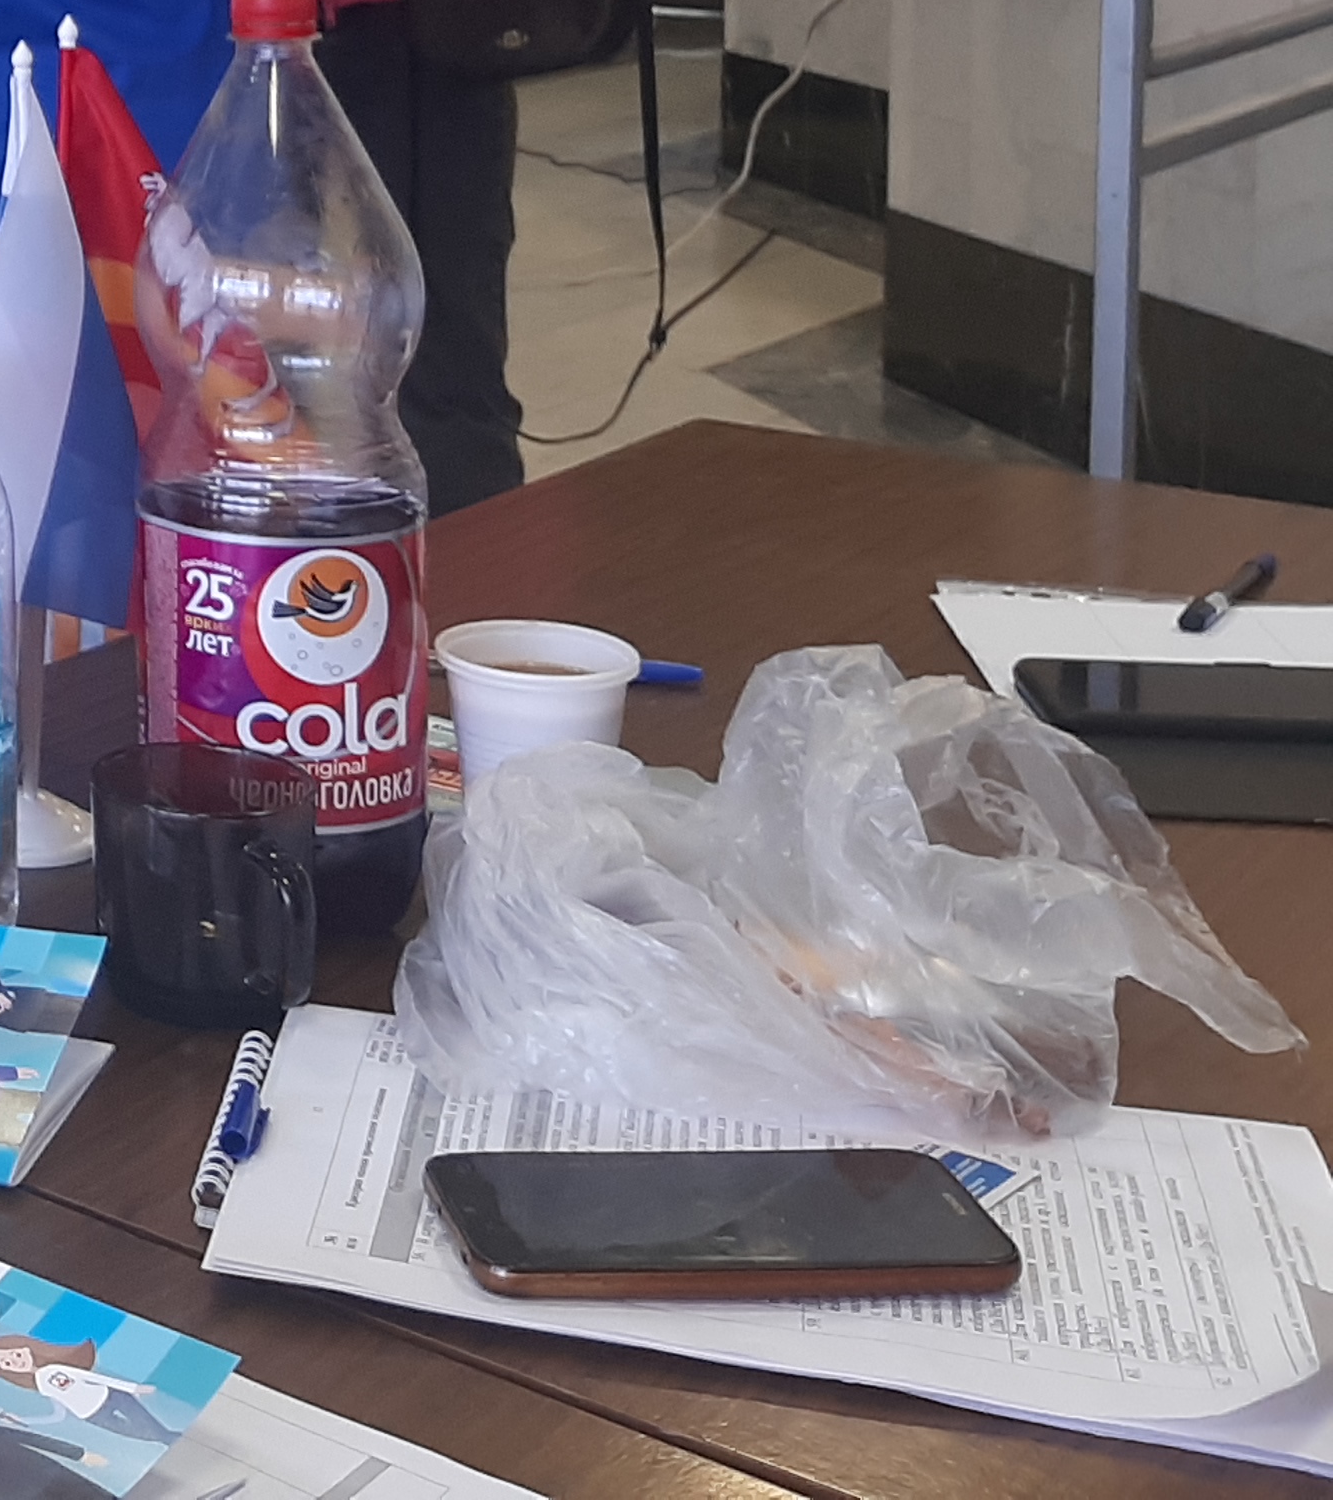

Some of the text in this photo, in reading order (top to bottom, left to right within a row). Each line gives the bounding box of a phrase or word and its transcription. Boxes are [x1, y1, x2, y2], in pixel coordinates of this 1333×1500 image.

[185, 568, 234, 620] 25
[185, 628, 233, 657] лет
[236, 682, 408, 758] cola
